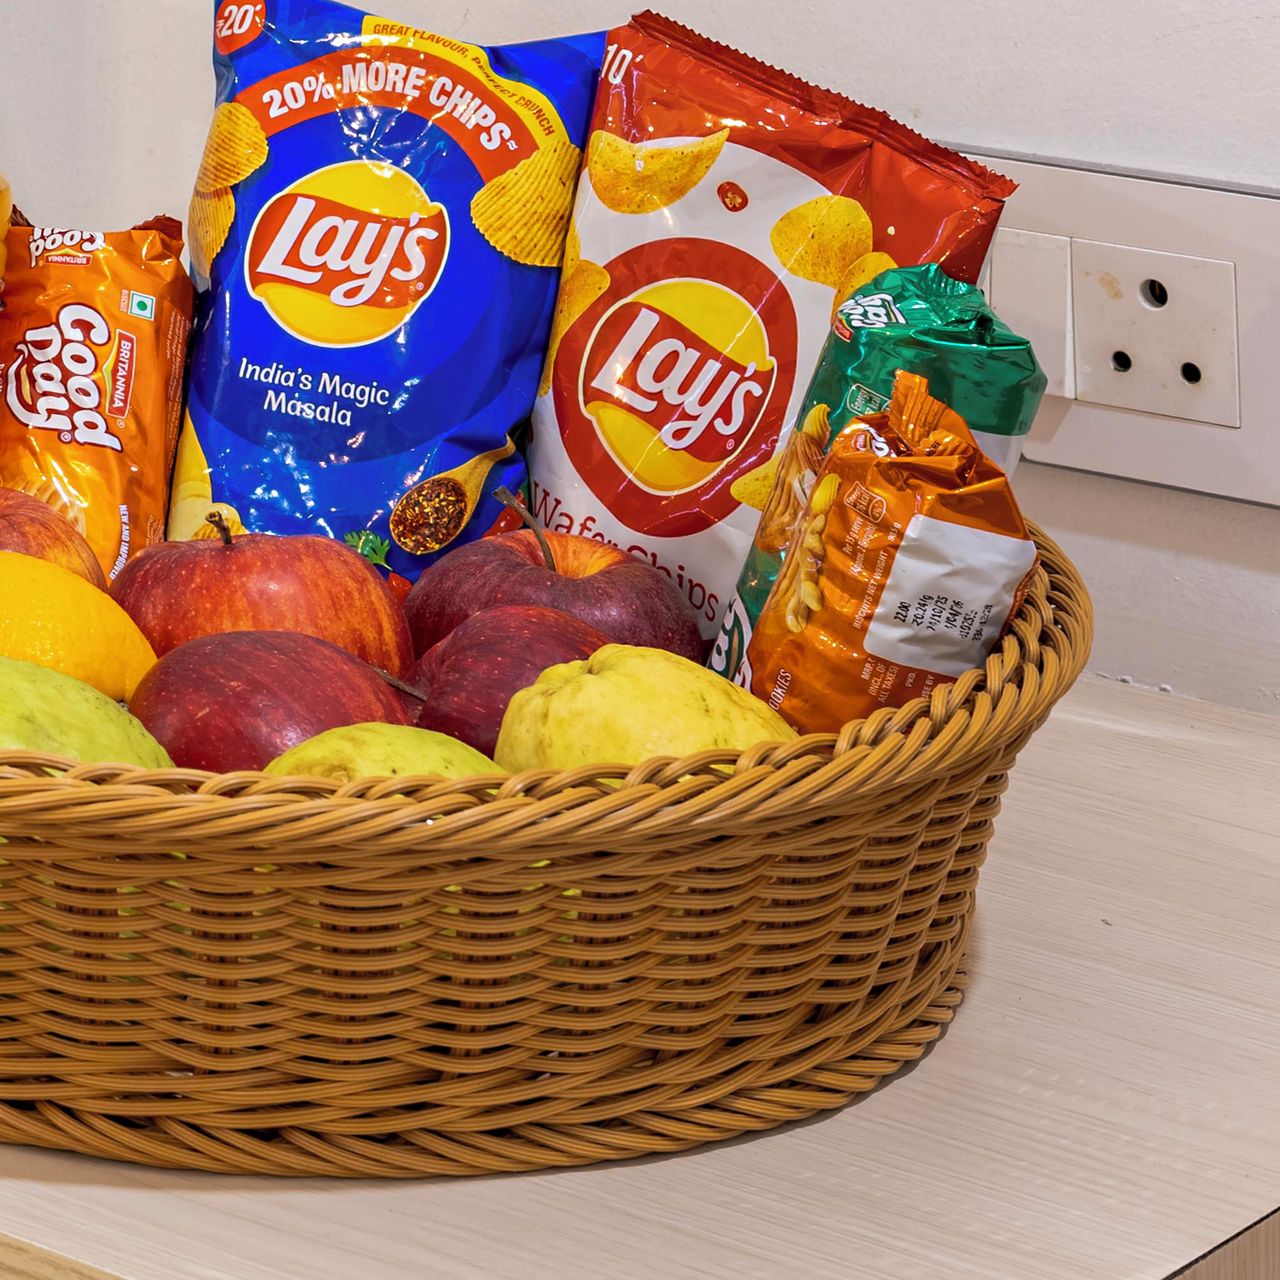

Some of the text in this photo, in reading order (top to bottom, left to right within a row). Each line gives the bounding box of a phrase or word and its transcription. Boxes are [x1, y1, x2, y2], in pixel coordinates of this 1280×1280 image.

[262, 72, 335, 118] 20%
[342, 61, 426, 97] MORE
[374, 23, 409, 36] GREAT
[515, 95, 556, 137] CRUNCH
[48, 255, 87, 264] BRITANNIA
[256, 196, 439, 307] Lay's
[6, 324, 72, 430] Day
[58, 304, 123, 451] Good
[113, 341, 132, 408] BRITANNIA
[238, 357, 390, 408] India's Magic
[590, 306, 764, 450] Lay's
[263, 390, 353, 426] Masala
[853, 389, 871, 411] Energy
[871, 394, 881, 408] kcal
[119, 504, 130, 524] NEW
[121, 523, 130, 541] AND
[532, 481, 619, 547] Waf
[842, 543, 853, 555] Per
[853, 550, 889, 630] BISCUITS NET WEIGHT
[894, 601, 911, 623] 22.00
[876, 663, 887, 673] OF
[878, 665, 900, 703] ALL TAXES)
[925, 675, 936, 686] BY
[768, 668, 792, 710] OOKIES
